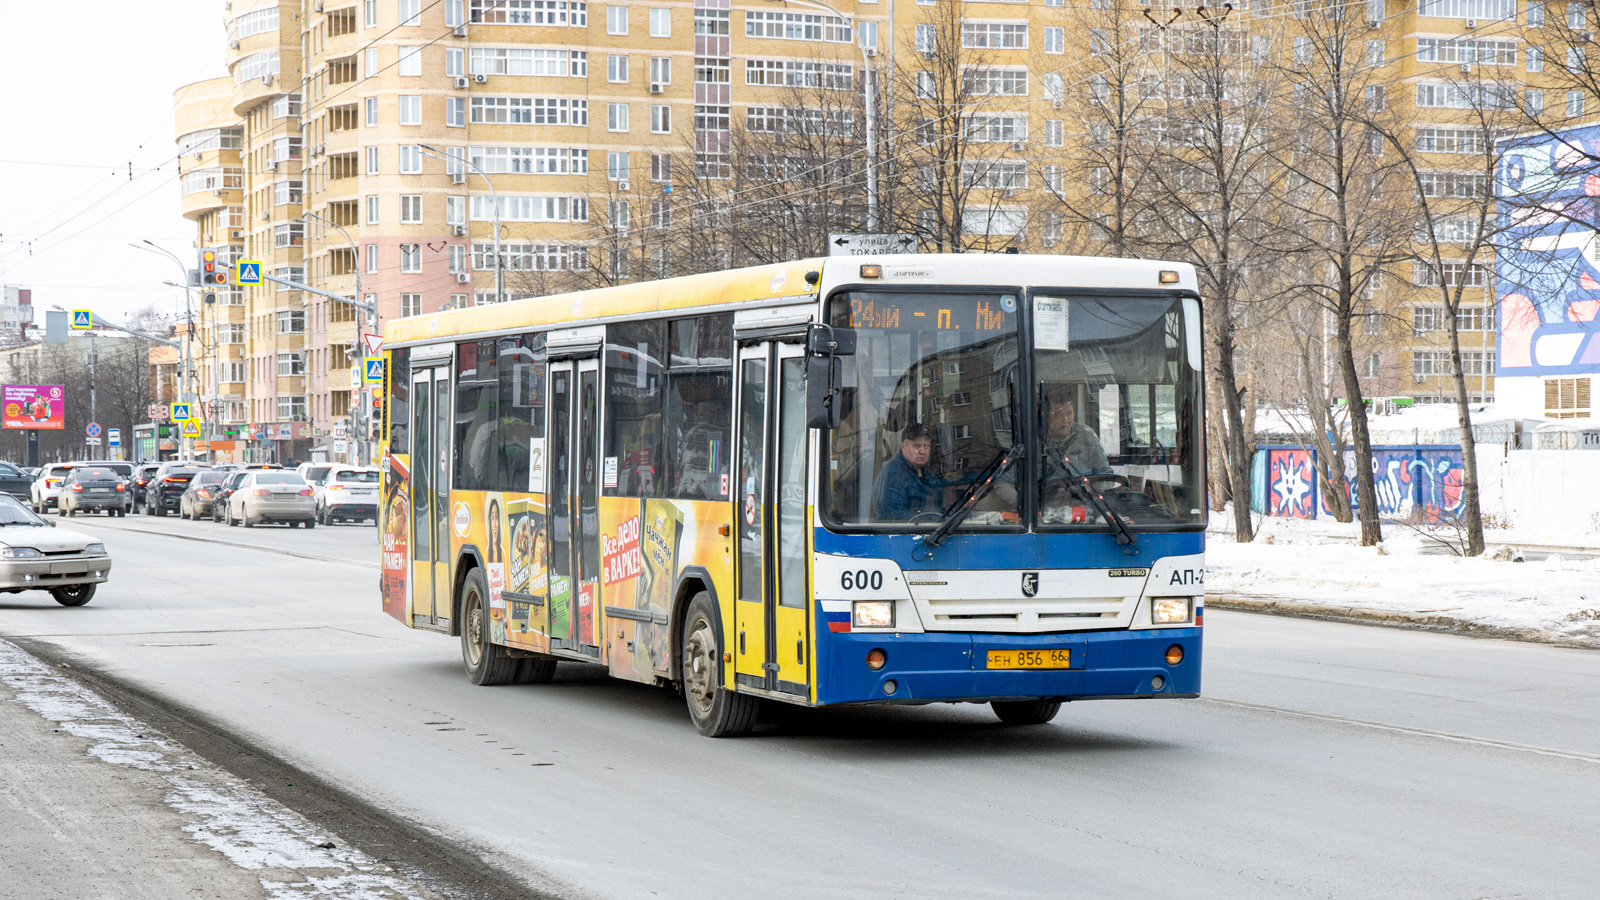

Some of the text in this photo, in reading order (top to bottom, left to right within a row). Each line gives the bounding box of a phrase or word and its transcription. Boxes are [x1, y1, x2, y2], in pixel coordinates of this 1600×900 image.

[859, 238, 888, 246] улица
[849, 299, 899, 328] 24ый
[976, 301, 1005, 330] Ми
[383, 533, 395, 551] ЧАН
[602, 534, 617, 557] Все
[384, 551, 403, 570] РАМЕН
[610, 546, 640, 581] ВАРКЕ!
[841, 570, 883, 590] 600
[1018, 652, 1042, 665] 856
[1052, 651, 1063, 661] 66
